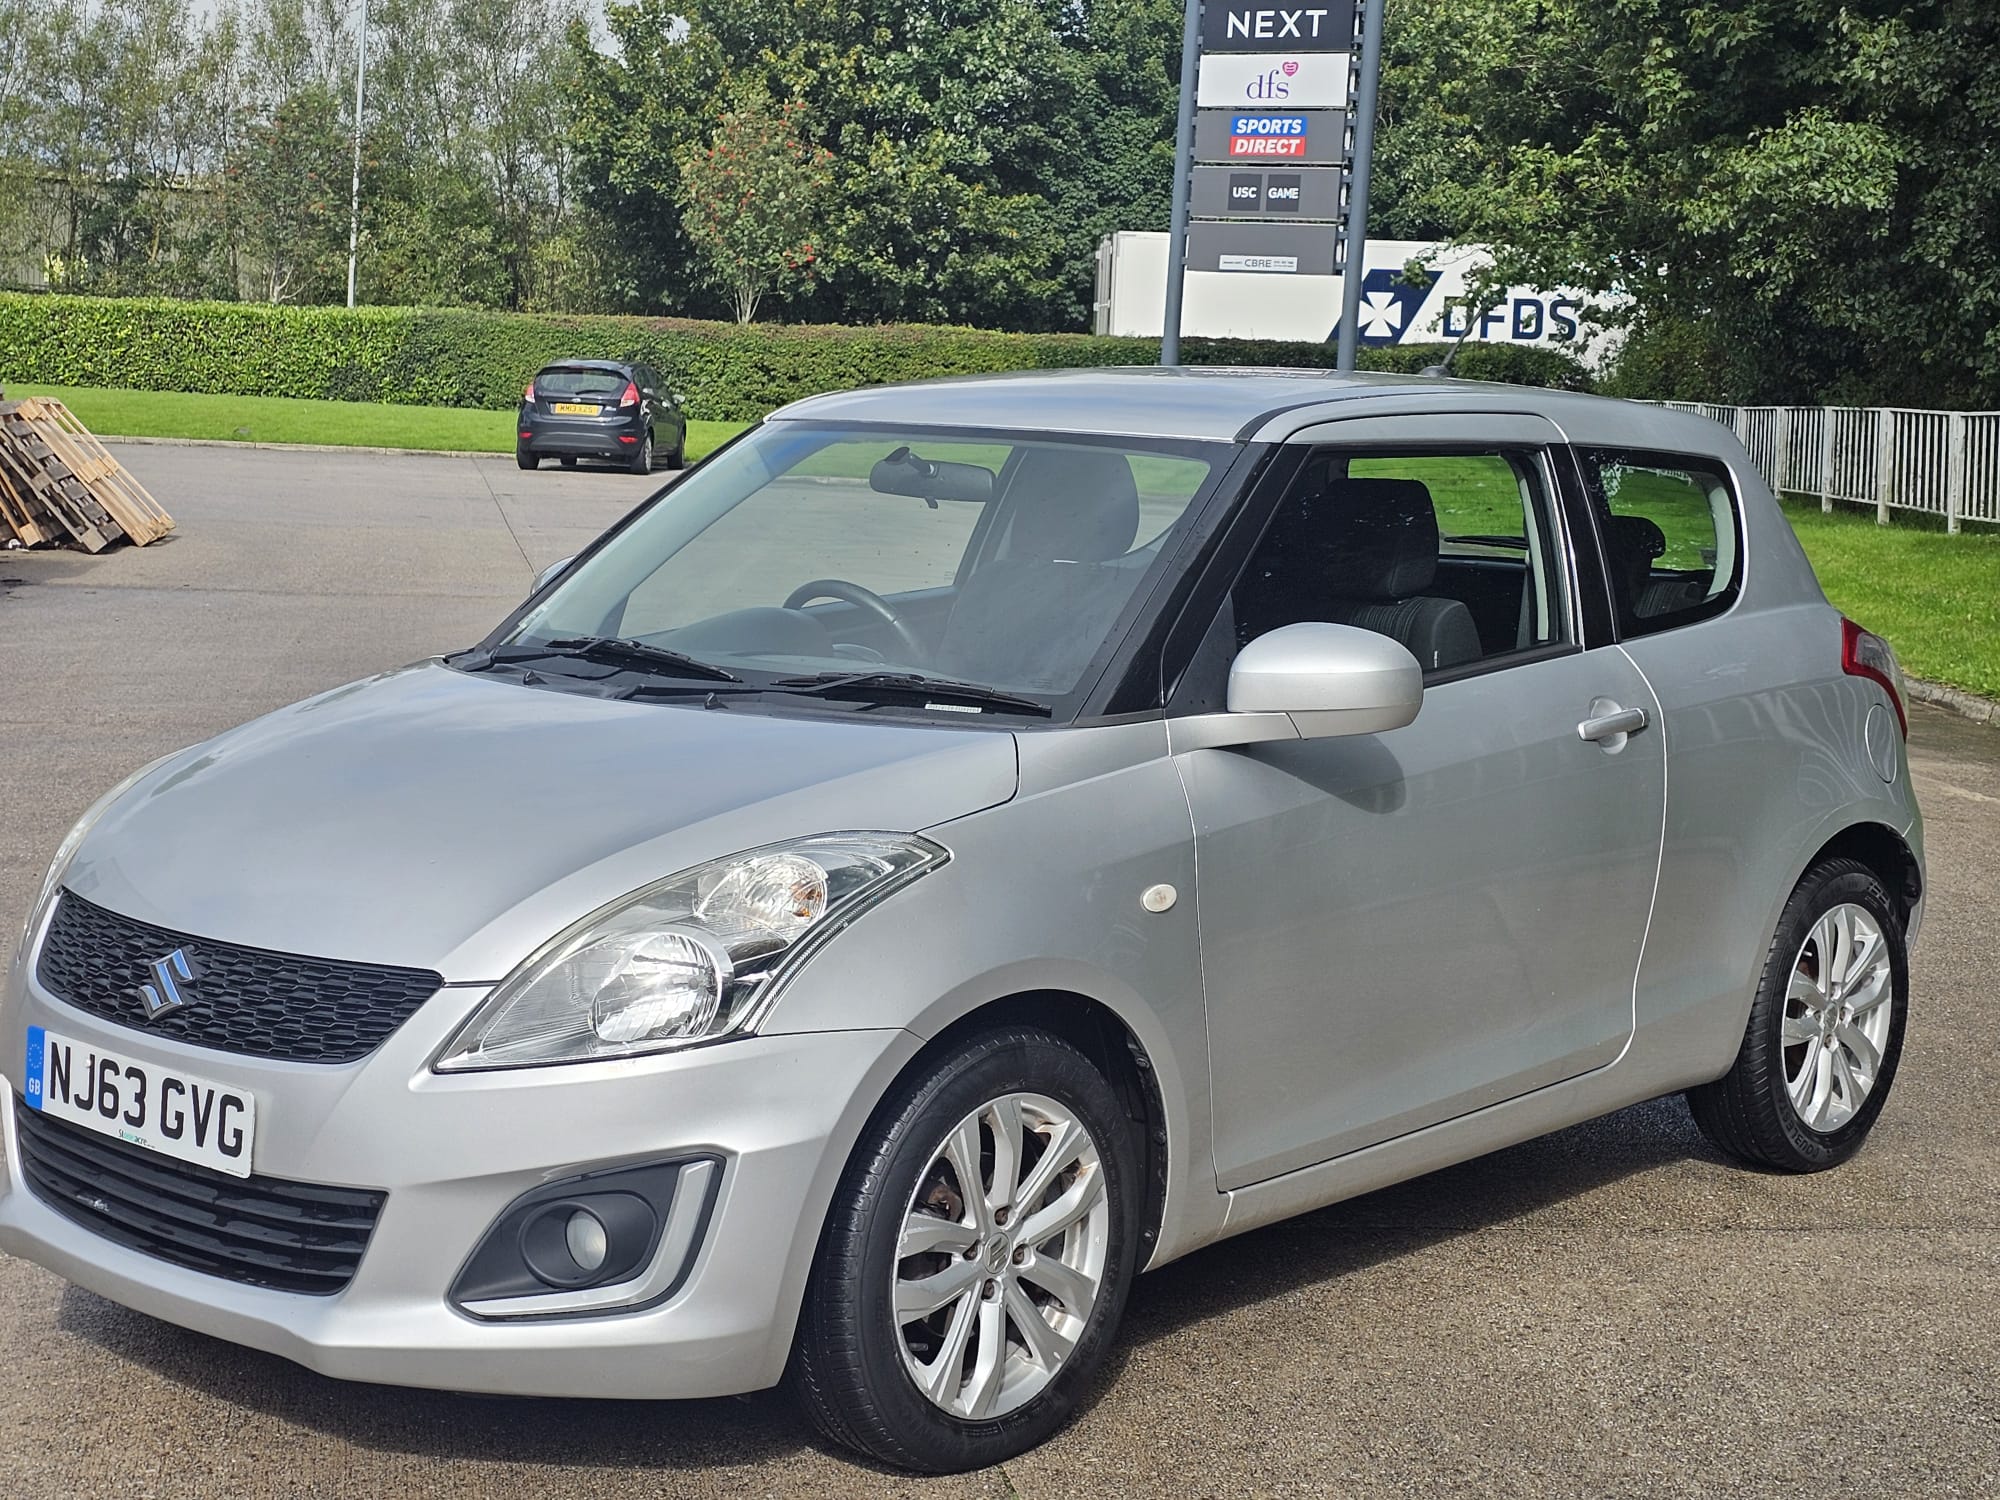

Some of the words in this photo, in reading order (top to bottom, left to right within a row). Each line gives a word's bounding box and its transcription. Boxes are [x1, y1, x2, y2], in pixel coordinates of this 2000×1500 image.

[1226, 9, 1328, 39] NEXT
[1246, 69, 1290, 99] dfs
[1235, 118, 1303, 134] SPORTS
[1234, 138, 1301, 154] DIRECT
[1232, 186, 1258, 198] USC
[1267, 187, 1300, 199] GAME
[1244, 258, 1273, 268] CBRE
[1442, 295, 1584, 341] DFDS
[28, 1077, 41, 1096] GB
[49, 1041, 147, 1129] NJ63
[160, 1077, 245, 1158] GVG
